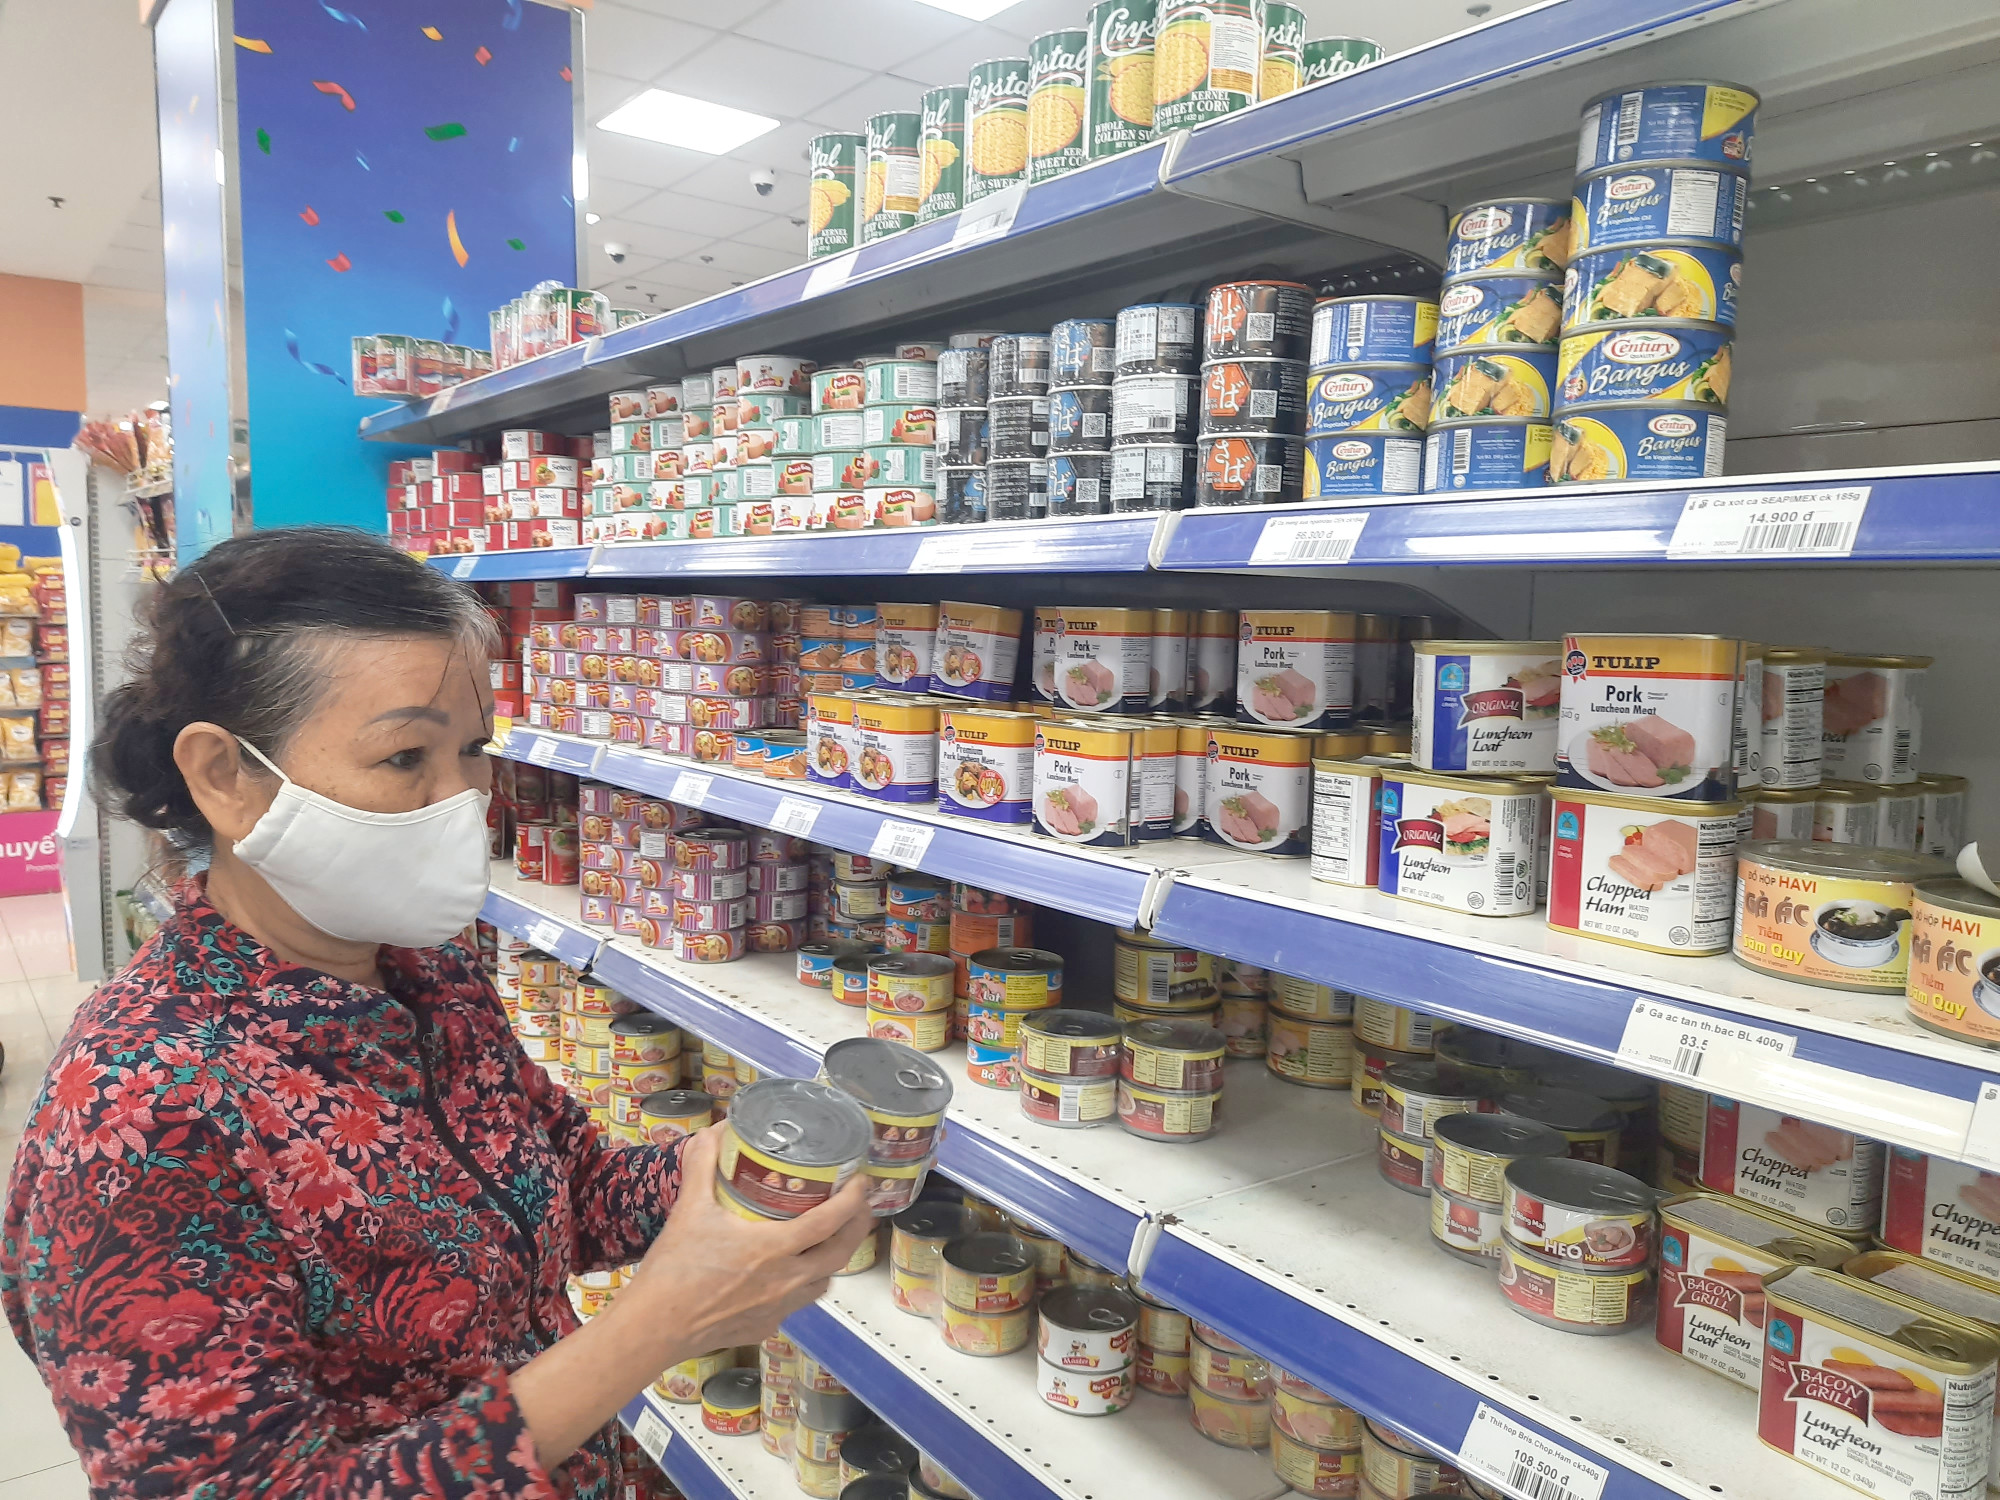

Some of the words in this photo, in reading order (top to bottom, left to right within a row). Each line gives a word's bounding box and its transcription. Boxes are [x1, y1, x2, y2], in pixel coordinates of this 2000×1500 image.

[1191, 91, 1230, 101] KERNEL
[1196, 101, 1230, 113] CORN
[1095, 121, 1125, 134] WHOLE
[1095, 129, 1136, 145] GOLDEN
[1611, 182, 1651, 197] Century
[1597, 193, 1664, 225] Bangus
[1611, 338, 1675, 356] Century
[1589, 361, 1690, 394] Bangus
[1324, 382, 1368, 397] Century
[1608, 386, 1649, 396] Vegetable
[1313, 397, 1383, 427] Bangus
[1653, 419, 1694, 432] Century
[1637, 437, 1702, 457] Bangus
[1326, 457, 1379, 479] Bangus
[1761, 494, 1817, 505] SEAPIMEX
[1835, 492, 1861, 502] 185g
[1749, 511, 1799, 524] 14.900
[1068, 621, 1098, 631] TULIP
[1255, 626, 1295, 636] TULIP
[1074, 640, 1091, 652] Pork
[1263, 646, 1285, 660] Pork
[1592, 655, 1661, 670] TULIP
[1605, 684, 1643, 703] Pork
[1471, 699, 1520, 714] ORIGINAL
[1590, 702, 1630, 715] Luncheon
[1632, 704, 1657, 716] Meat
[957, 729, 988, 740] TULIP
[1472, 726, 1533, 741] Luncheon
[956, 743, 983, 756] Premium
[1047, 738, 1081, 751] TULIP
[1221, 744, 1260, 758] TULIP
[1472, 740, 1505, 753] Loaf
[1054, 760, 1073, 774] Pork
[1229, 766, 1251, 782] Pork
[1402, 829, 1442, 845] ORIGINAL
[1402, 854, 1451, 875] Luncheon
[1402, 869, 1427, 883] Loaf
[1778, 874, 1818, 894] HAVI
[1586, 874, 1653, 904] Chopped
[1585, 896, 1625, 917] Ham
[1628, 904, 1649, 914] WATER
[1745, 889, 1769, 919] GÀ
[1774, 896, 1811, 928] ÁC
[1628, 912, 1648, 922] ADDED
[1584, 920, 1594, 928] NET
[1622, 927, 1640, 939] (340g)
[1941, 914, 1981, 937] HAVI
[1771, 943, 1806, 967] Quy
[1936, 939, 1973, 977] ÁC
[812, 971, 830, 981] Heo
[1649, 1008, 1663, 1020] Ga
[1665, 1013, 1678, 1024] ac
[1680, 1016, 1698, 1029] tan
[1700, 1021, 1735, 1038] th.bac
[1737, 1031, 1752, 1043] BL
[1756, 1036, 1784, 1052] 400g
[1741, 1147, 1812, 1180] Chopped
[1740, 1165, 1781, 1190] Ham
[1530, 1216, 1546, 1231] Mai
[1544, 1237, 1583, 1259] HEO
[1527, 1282, 1538, 1292] 150
[1687, 1277, 1737, 1302] BACON
[1691, 1290, 1730, 1312] GRILL
[1688, 1327, 1722, 1349] Loaf
[1689, 1315, 1751, 1350] Luncheon
[1063, 1356, 1088, 1365] Master
[1800, 1367, 1864, 1400] BACON
[1806, 1383, 1855, 1411] GRILL
[1802, 1410, 1882, 1456] Luncheon
[1802, 1426, 1844, 1451] Loaf
[1488, 1415, 1503, 1429] Thit
[1504, 1422, 1517, 1437] hop
[1572, 1461, 1600, 1481] ck340g
[1514, 1449, 1558, 1480] 108.500
[1560, 1475, 1570, 1487] đ
[1801, 1447, 1816, 1459] NET
[1816, 1454, 1828, 1467] WT.
[1830, 1462, 1839, 1472] 12
[1852, 1472, 1876, 1490] (340g)
